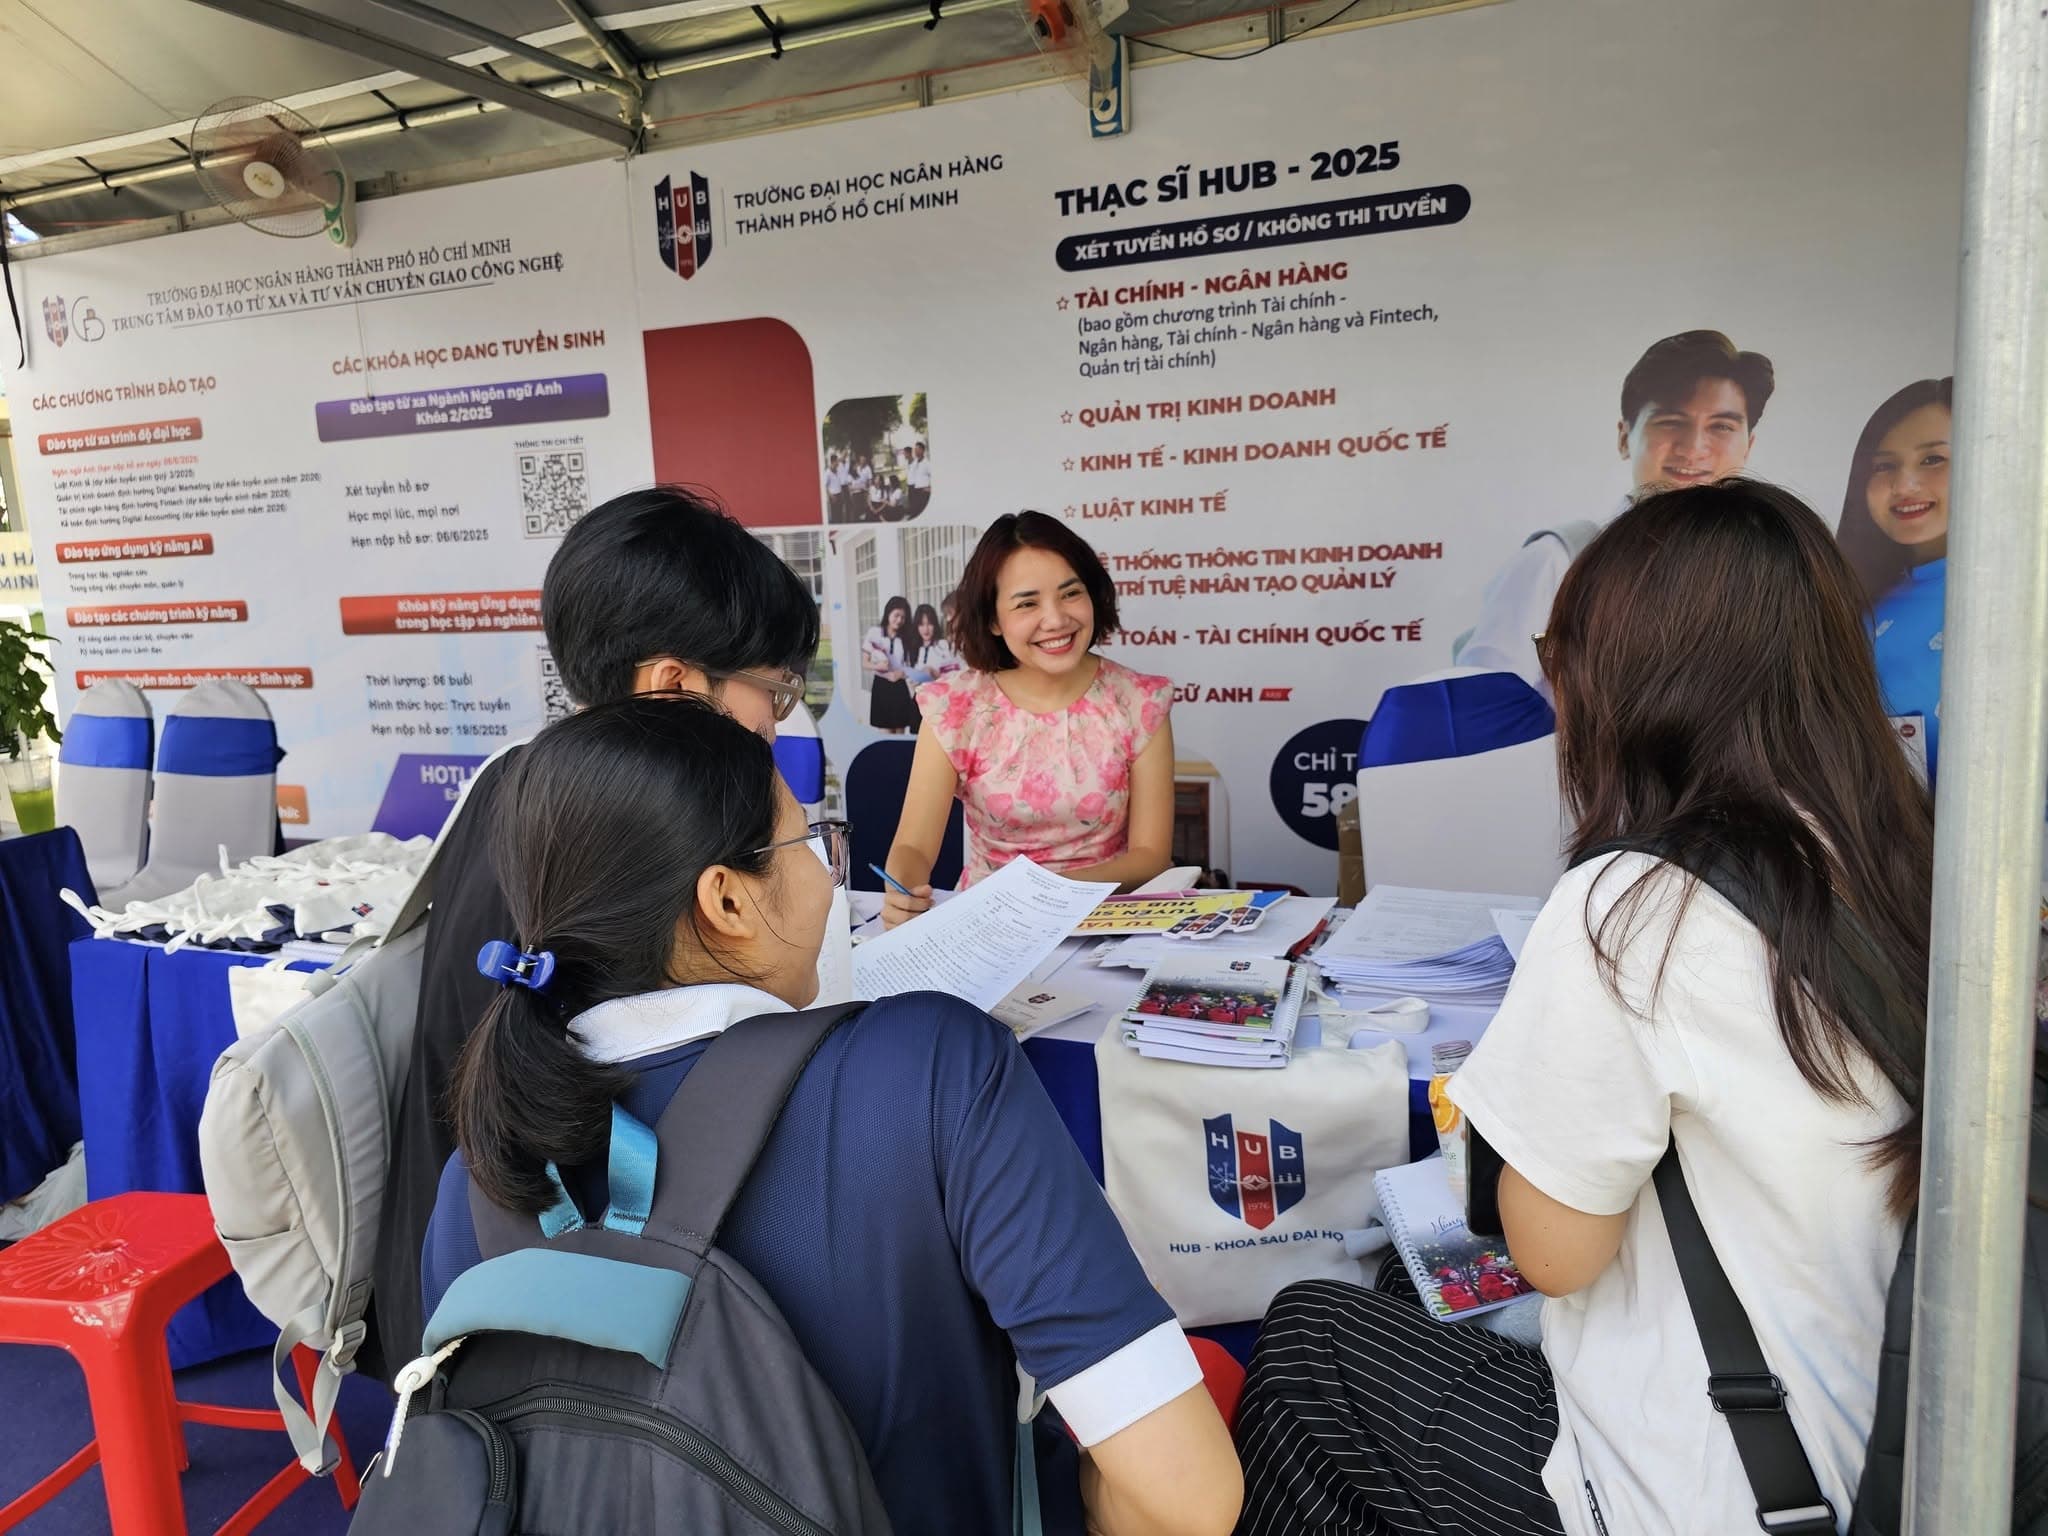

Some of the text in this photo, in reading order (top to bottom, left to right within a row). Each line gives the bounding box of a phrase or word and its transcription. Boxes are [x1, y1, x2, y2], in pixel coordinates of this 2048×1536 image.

[734, 153, 1004, 210] TRƯỜNG ĐẠI HỌC NGÂN HÀNG
[1055, 141, 1401, 217] THẠC SĨ HUB 2025
[658, 191, 707, 211] HUB
[735, 190, 959, 235] THÀNH PHỐ HỒ CHÍ MINH
[1075, 192, 1447, 262] XÉT TUYỂN HỒ SƠ KHÔNG THI TUYỂN
[147, 238, 512, 306] TRƯỜNG ĐẠI HỌC NGÂN HÀNG THÀNH PHỐ HỒ CHÍ MINH
[1074, 260, 1349, 310] TÀI CHÍNH NGÂN HÀNG
[112, 251, 564, 334] TRUNG TÂM ĐÀO TẠO TỪ XA VÀ TƯ VẤN CHUYỂN GIAO CÔNG NGHỆ
[1078, 290, 1336, 336] (bao gồm chương trình Tài chính
[1078, 304, 1439, 358] Ngân hàng, Tài chính Ngân hàng và Fintech,
[332, 329, 606, 376] CÁC KHÓA HỌC ĐANG TUYỂN SINH
[1079, 347, 1216, 379] Quản trị tài chính)
[32, 374, 217, 412] CÁC CHƯƠNG TRÌNH ĐÀO TẠO
[535, 381, 564, 396] Anh
[449, 404, 493, 424] 2/2025
[1079, 388, 1337, 428] QUẢN TRỊ KINH DOANH
[1080, 424, 1450, 472] KINH TẾ KINH DOANH QUỐC TẾ
[1081, 489, 1230, 521] LUẬT KINH TẾ
[1113, 541, 1442, 572] THỐNG THÔNG TIN KINH DOANH
[1115, 567, 1397, 600] TRÍ TUỆ NHÂN TẠO QUẢN LÝ
[1118, 625, 1176, 647] TOÁN
[1196, 625, 1231, 646] TÀI
[1237, 621, 1309, 645] CHÍNH
[1315, 620, 1386, 649] QUỐC
[1392, 619, 1425, 642] TẾ
[1204, 687, 1254, 703] ANH
[1294, 747, 1336, 771] CHỈ
[1211, 1132, 1297, 1159] HUB
[1169, 1229, 1344, 1254] HUB KHOA SAU ĐẠI HỌ
